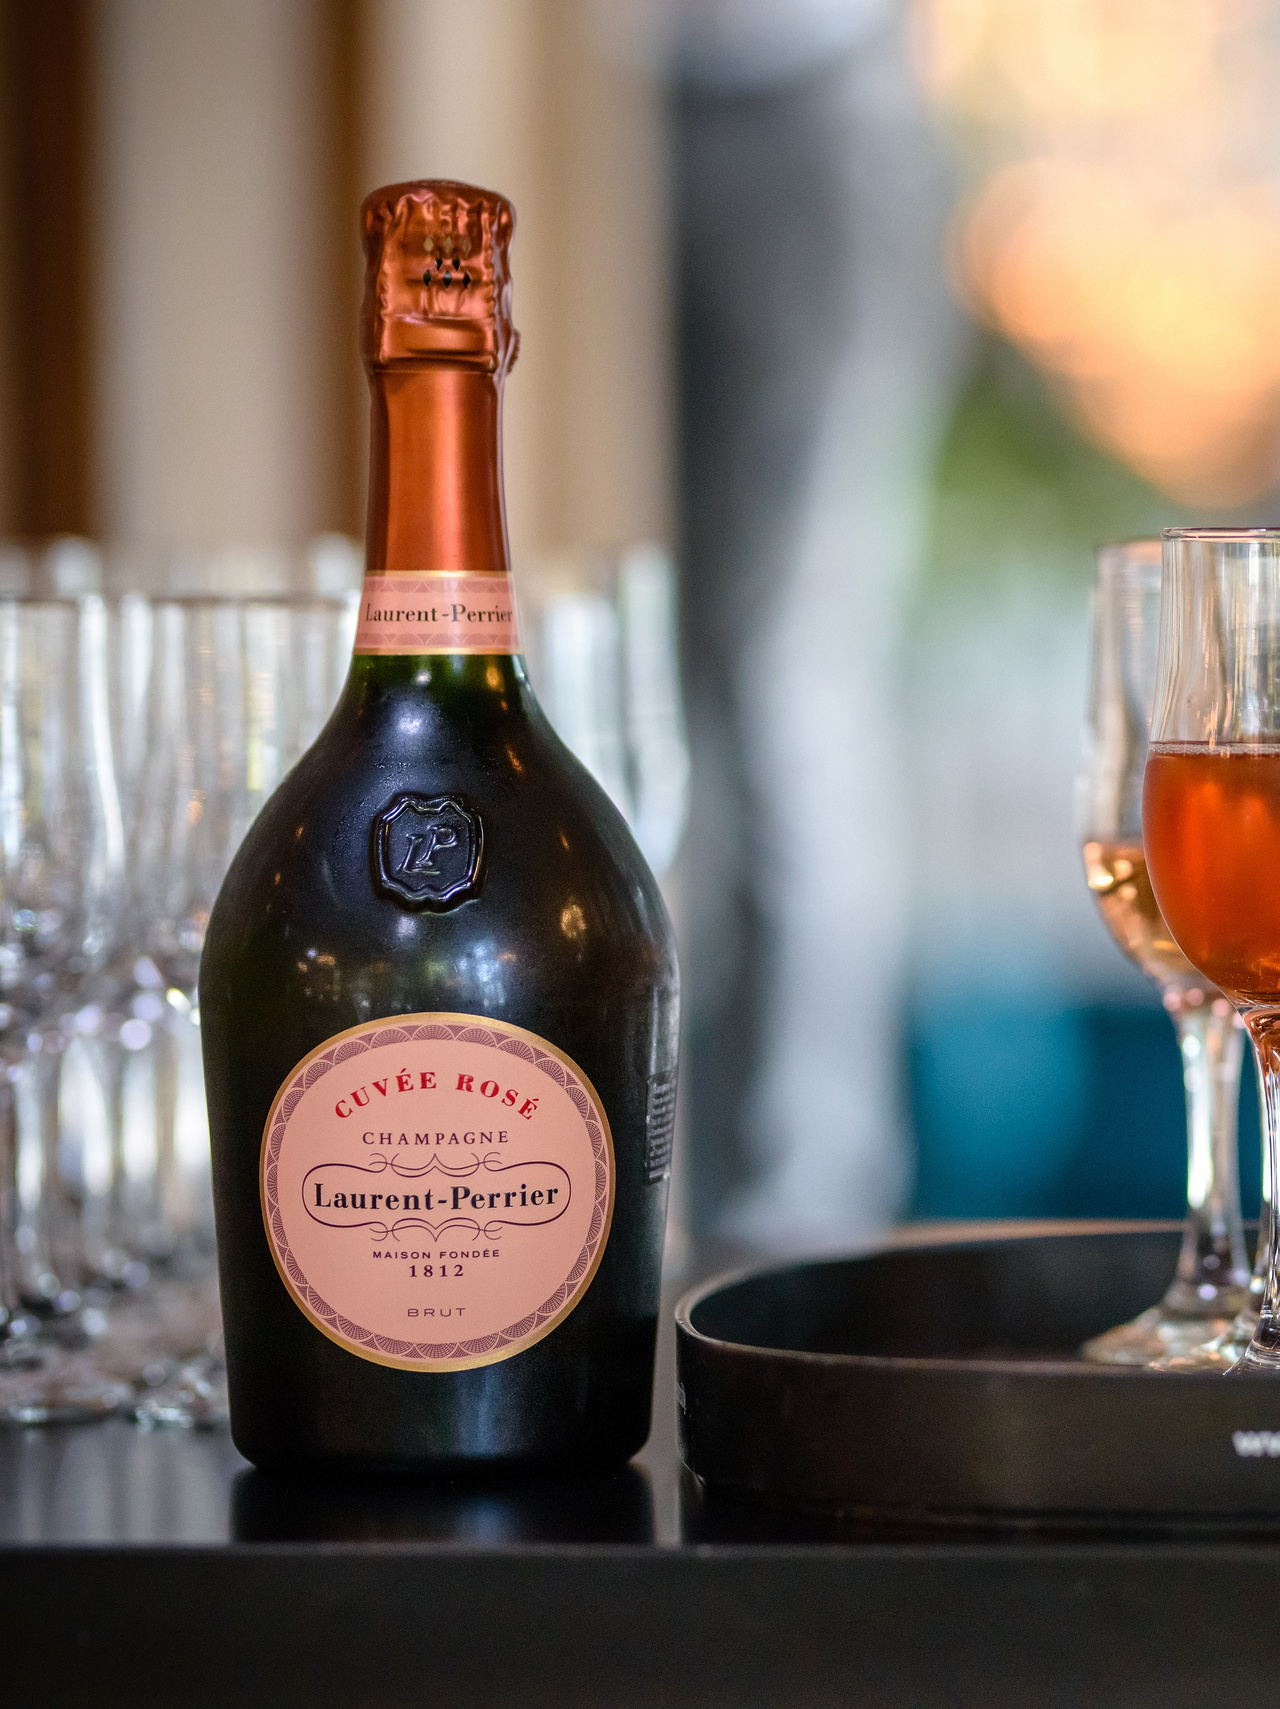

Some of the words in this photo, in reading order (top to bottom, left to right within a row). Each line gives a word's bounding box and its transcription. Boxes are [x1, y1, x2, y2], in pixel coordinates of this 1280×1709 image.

[365, 602, 513, 623] Laurent-Perrier
[334, 1067, 437, 1119] CUVÉE
[455, 1072, 540, 1121] ROSÉ
[362, 1130, 509, 1146] CHAMPAGNE
[314, 1182, 559, 1211] Laurent-Perrier
[372, 1250, 431, 1260] MAISON
[439, 1248, 501, 1260] FONDÉE
[408, 1263, 465, 1278] 1812
[407, 1307, 467, 1318] BRUT
